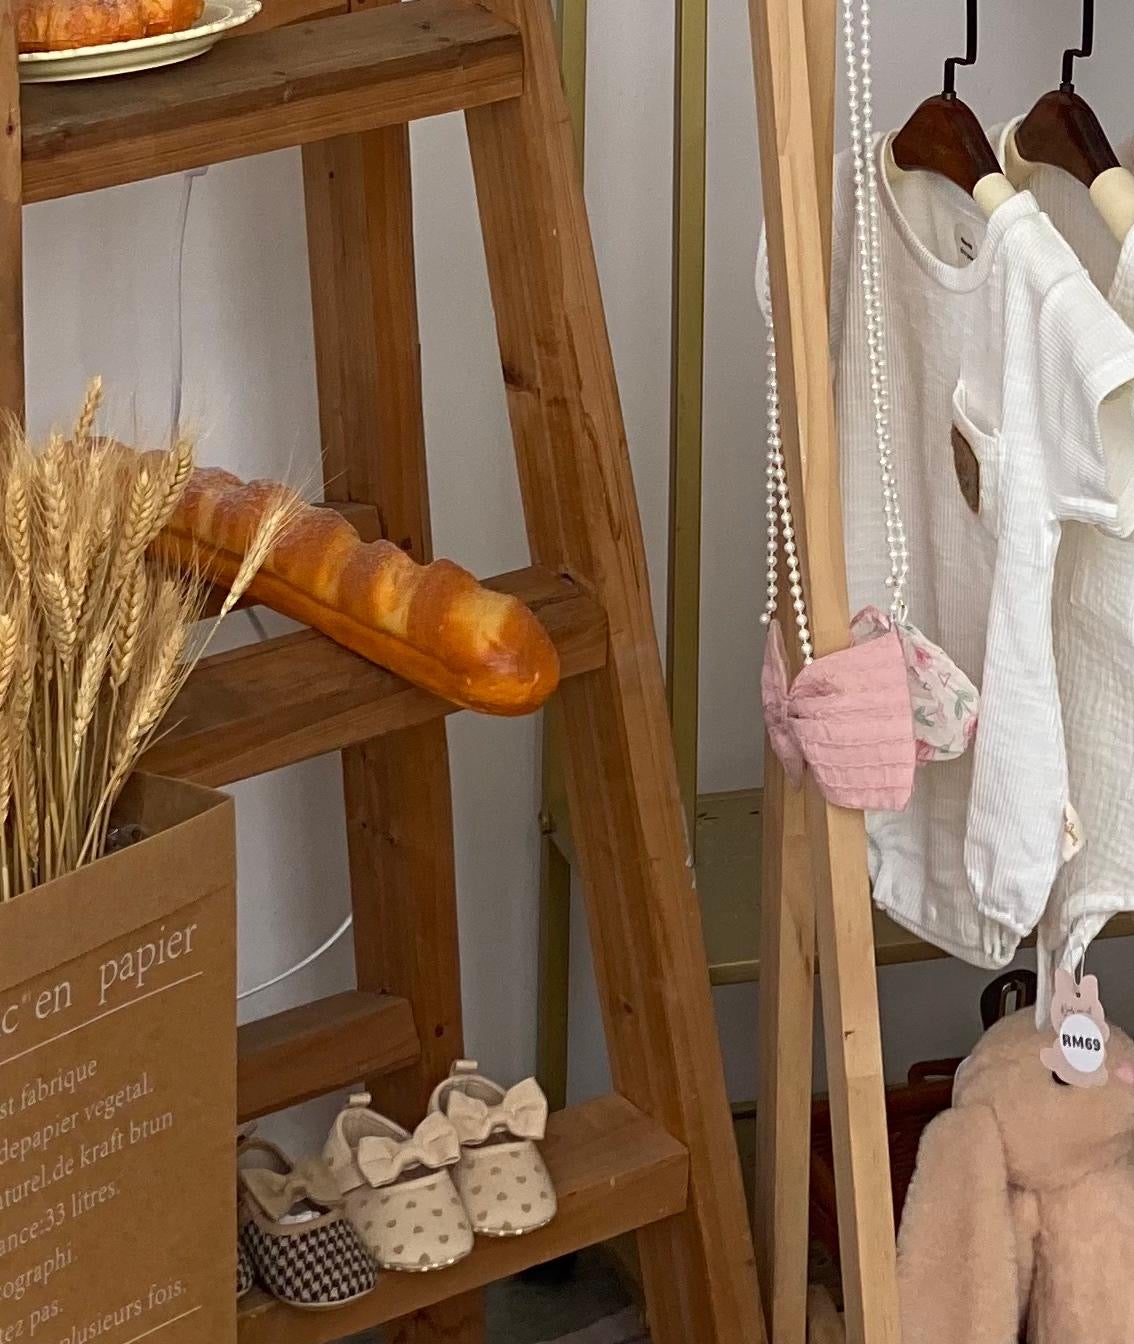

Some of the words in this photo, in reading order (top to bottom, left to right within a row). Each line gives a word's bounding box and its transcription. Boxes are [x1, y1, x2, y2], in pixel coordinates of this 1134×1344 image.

[98, 924, 198, 1006] papier
[1062, 1033, 1101, 1052] RM69
[20, 1060, 97, 1110] fabrique
[80, 1127, 124, 1168] kraft
[0, 1241, 77, 1301] ographi.
